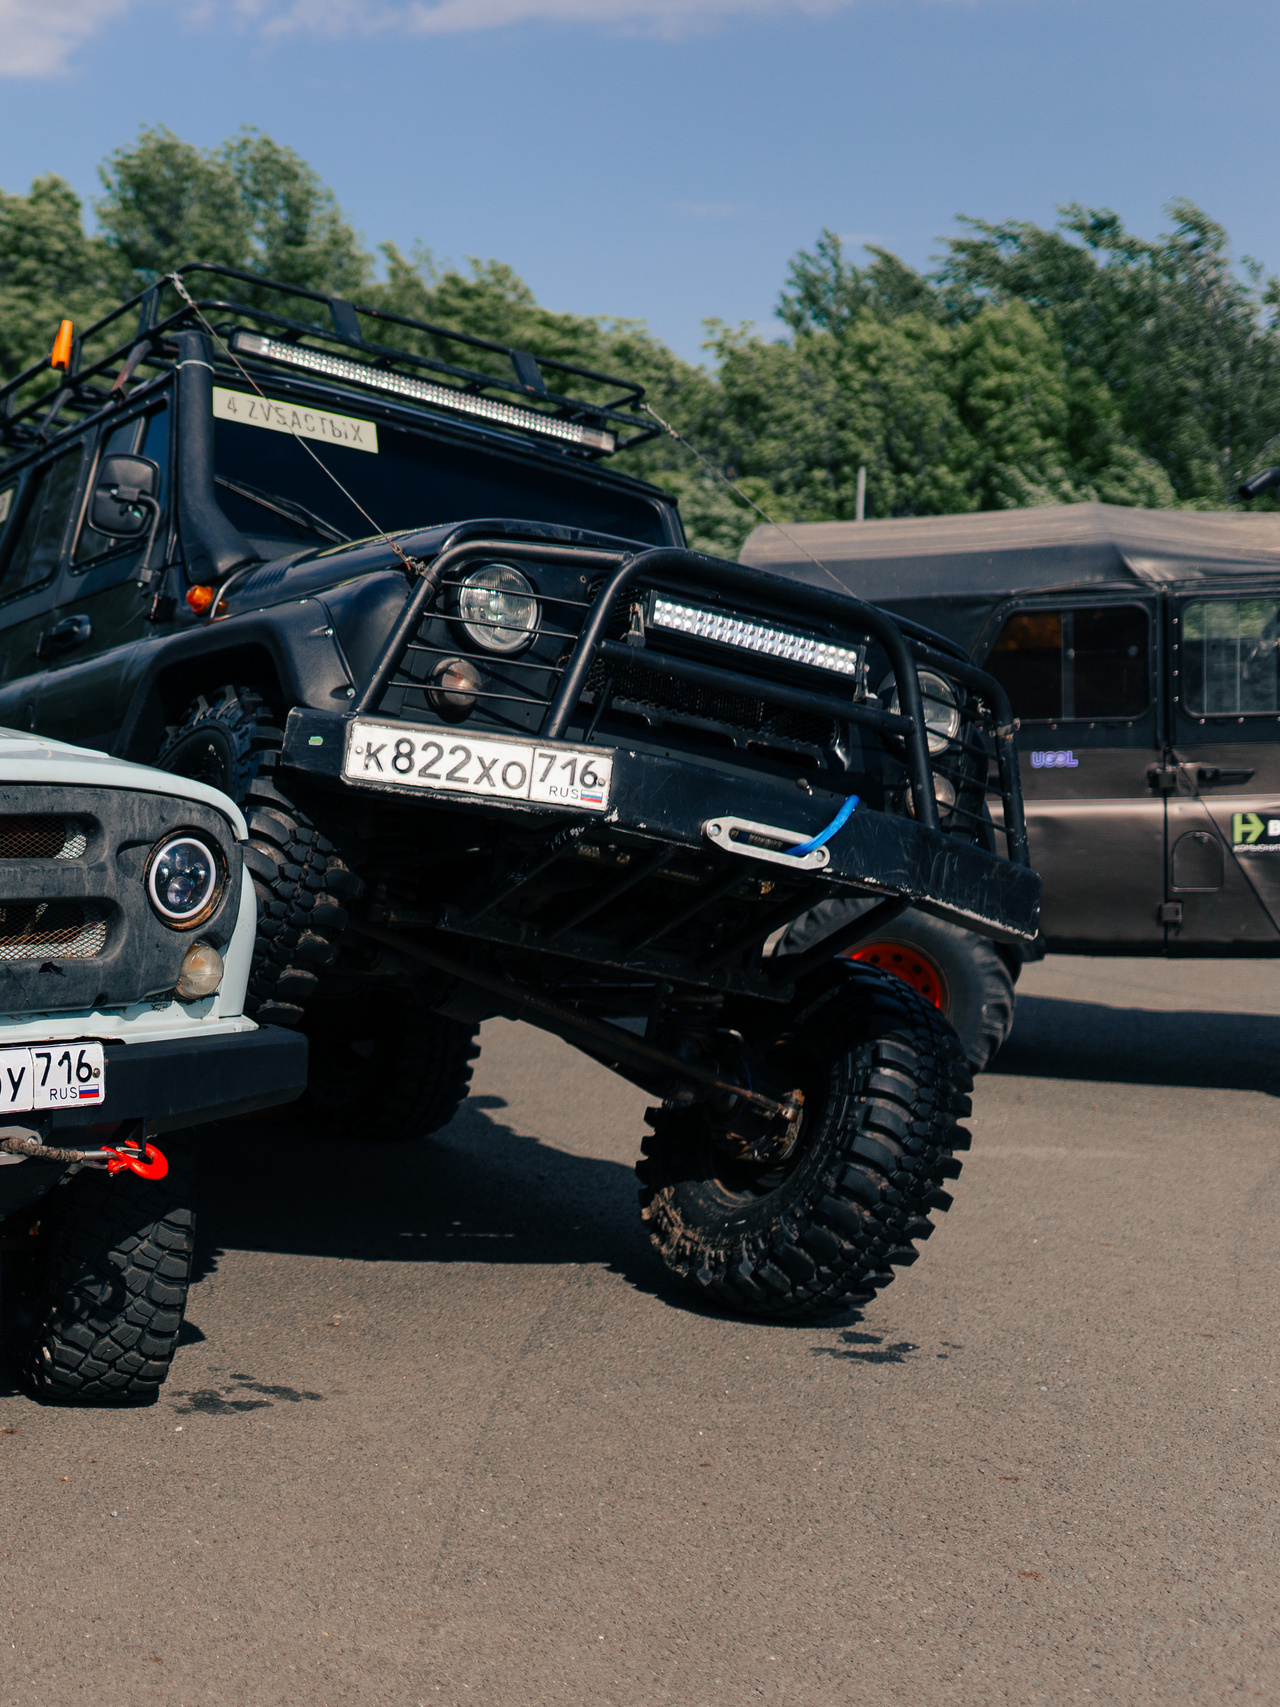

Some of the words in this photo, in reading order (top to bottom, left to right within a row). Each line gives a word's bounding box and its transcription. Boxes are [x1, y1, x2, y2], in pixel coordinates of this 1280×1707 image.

[227, 397, 237, 415] 4
[538, 752, 598, 789] 716
[548, 785, 580, 800] RUS
[35, 1049, 93, 1087] 716
[49, 1087, 78, 1101] RUS
